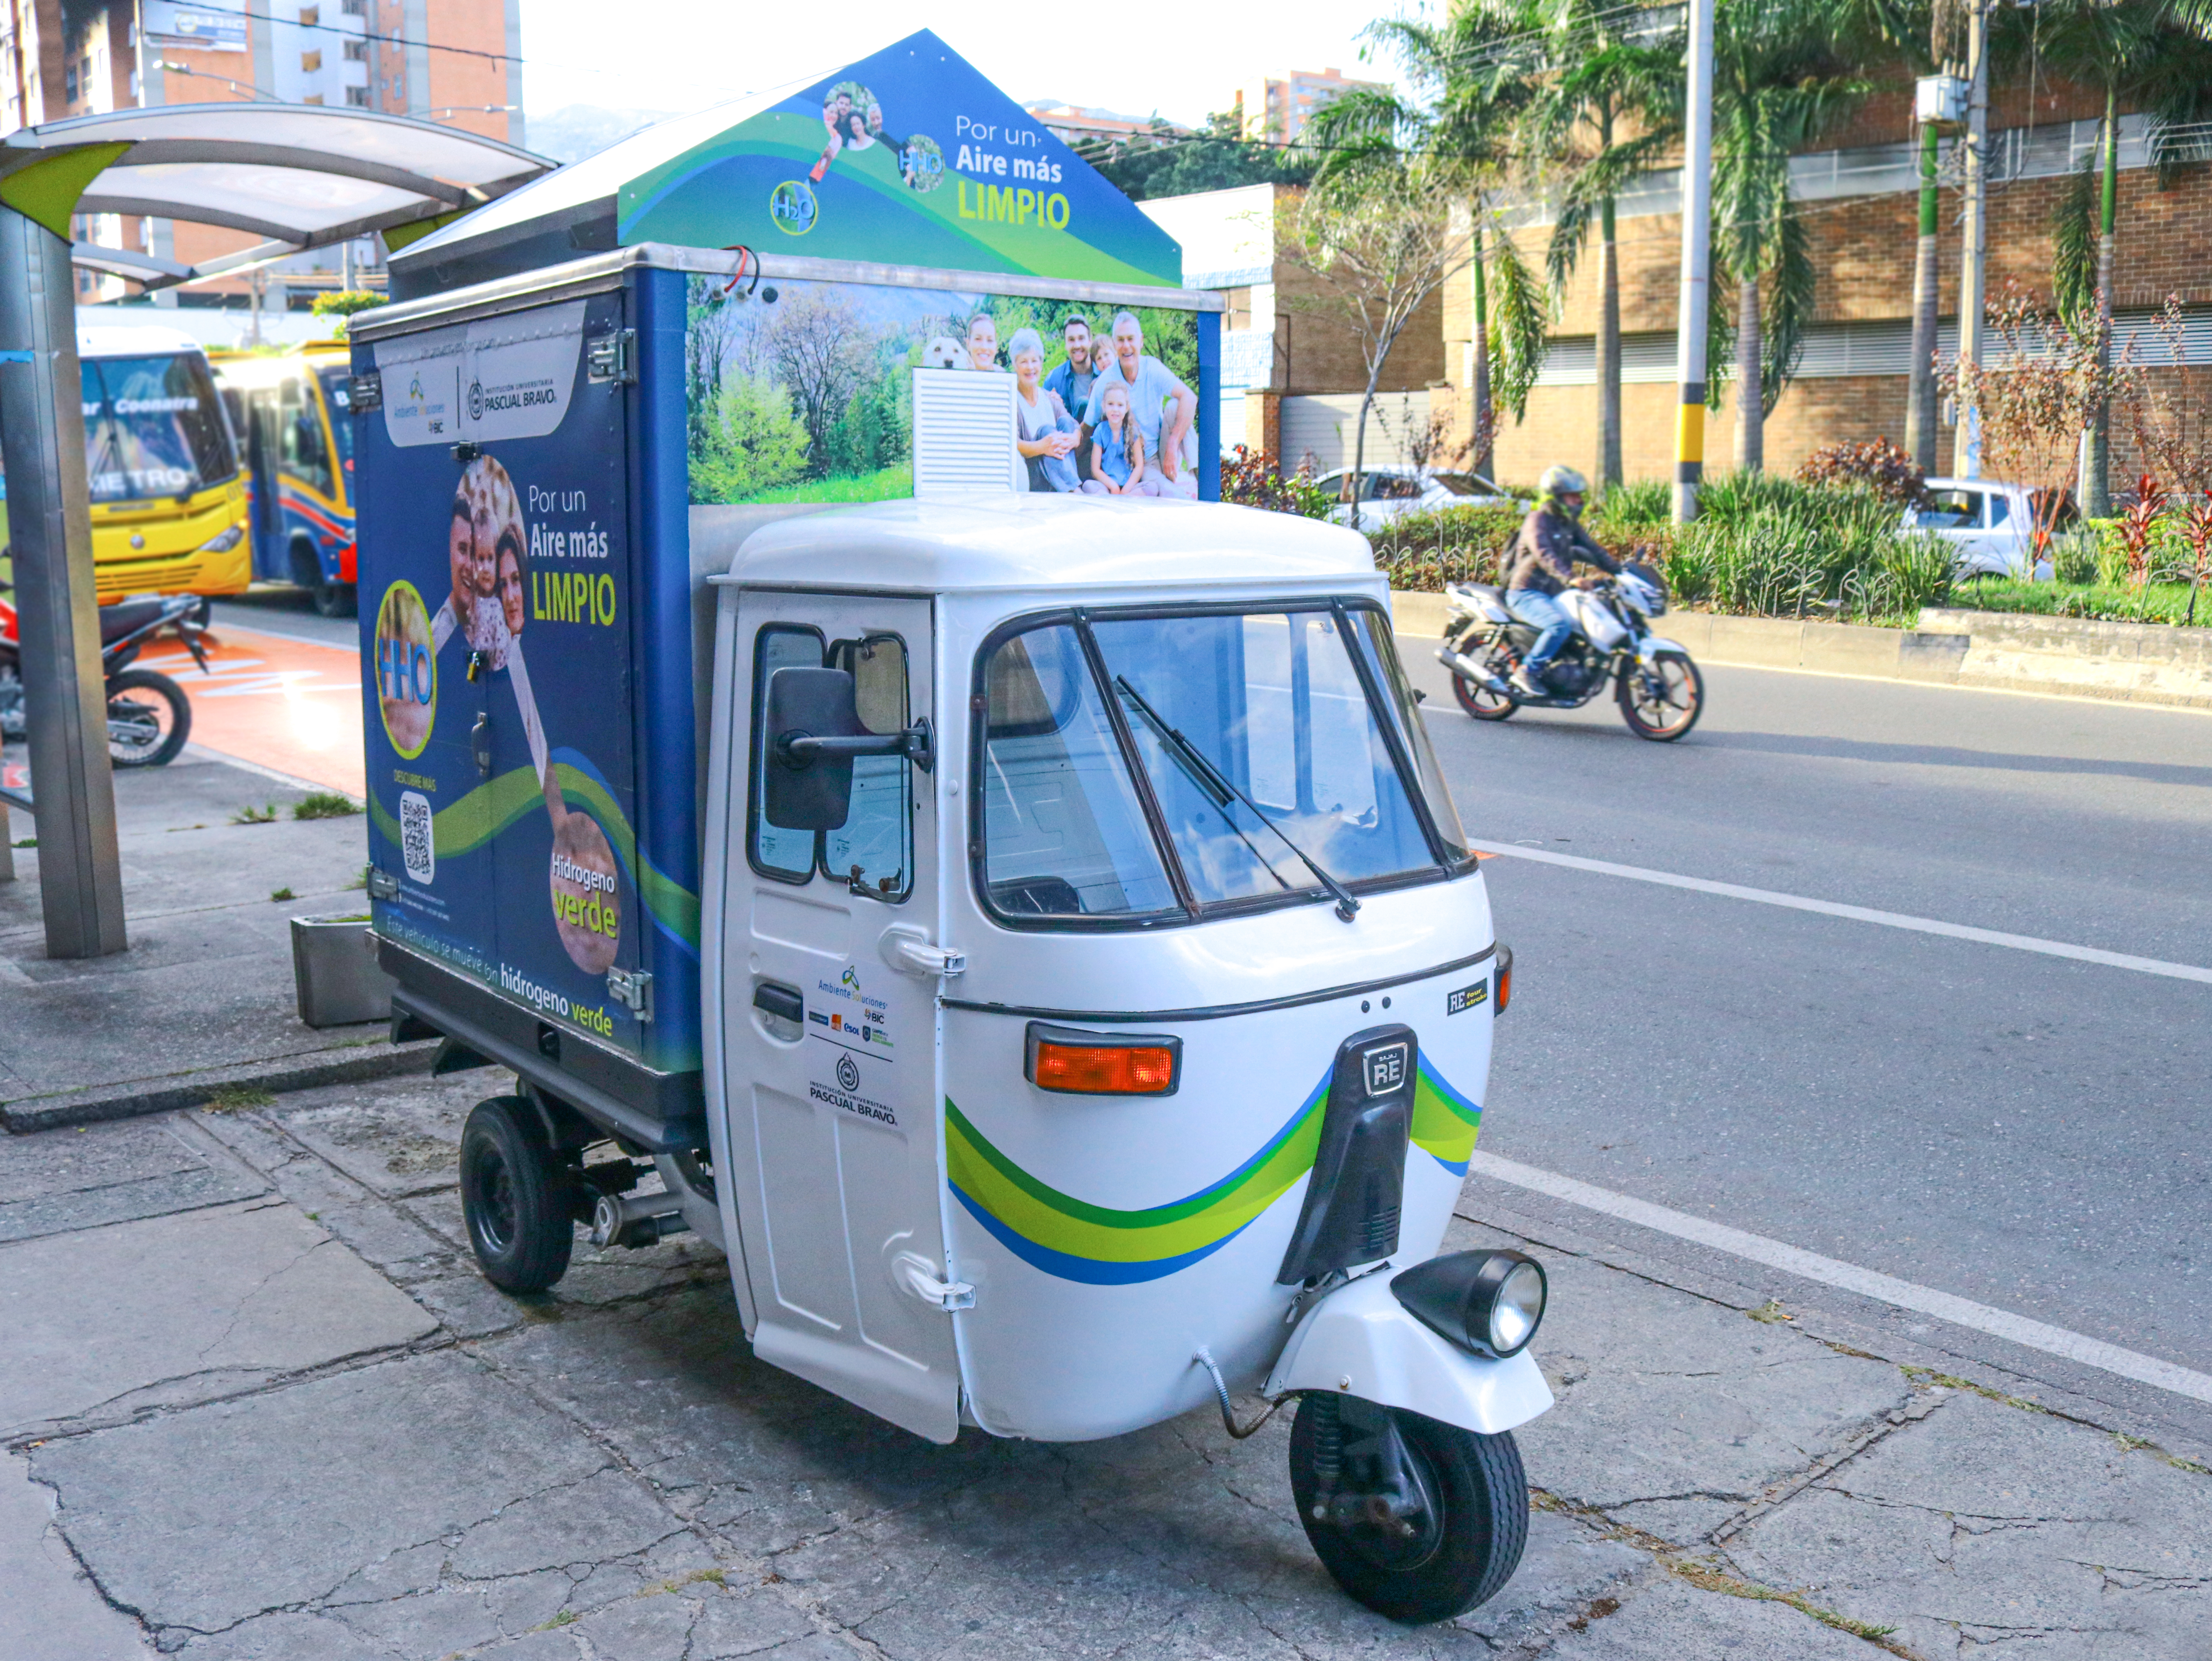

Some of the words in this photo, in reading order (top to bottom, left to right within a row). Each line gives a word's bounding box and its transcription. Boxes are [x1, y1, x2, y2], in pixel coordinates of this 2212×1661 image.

[955, 115, 997, 141] Por
[1005, 128, 1036, 148] un
[898, 149, 943, 174] HHO
[955, 144, 1007, 175] Aire
[1013, 155, 1062, 184] más
[958, 180, 1070, 230] LIMPIO
[484, 394, 521, 412] PASCUAL
[523, 388, 554, 407] BRAVO
[529, 485, 556, 512] Por
[562, 490, 586, 512] un
[530, 522, 565, 557] Aire
[570, 521, 608, 558] más
[532, 571, 616, 626] LIMPIO
[379, 638, 432, 705] HHO
[552, 853, 615, 893] Hidrogeno
[553, 889, 617, 938] verde
[453, 948, 482, 972] mueve
[501, 963, 569, 1016] hidrogeno
[571, 1000, 613, 1037] verde
[818, 979, 851, 999] Ambiente
[1450, 991, 1465, 1012] RE
[1467, 988, 1482, 999] four
[1466, 993, 1487, 1006] stroke
[871, 1013, 884, 1024] BIC
[1373, 1060, 1400, 1085] RE
[1379, 1053, 1397, 1062] BAJAJ
[810, 1080, 846, 1097] INSTITUCIÓN
[848, 1094, 893, 1113] UNIVERSITARIA
[810, 1087, 856, 1112] PASCUAL
[858, 1104, 895, 1124] BRAVO
